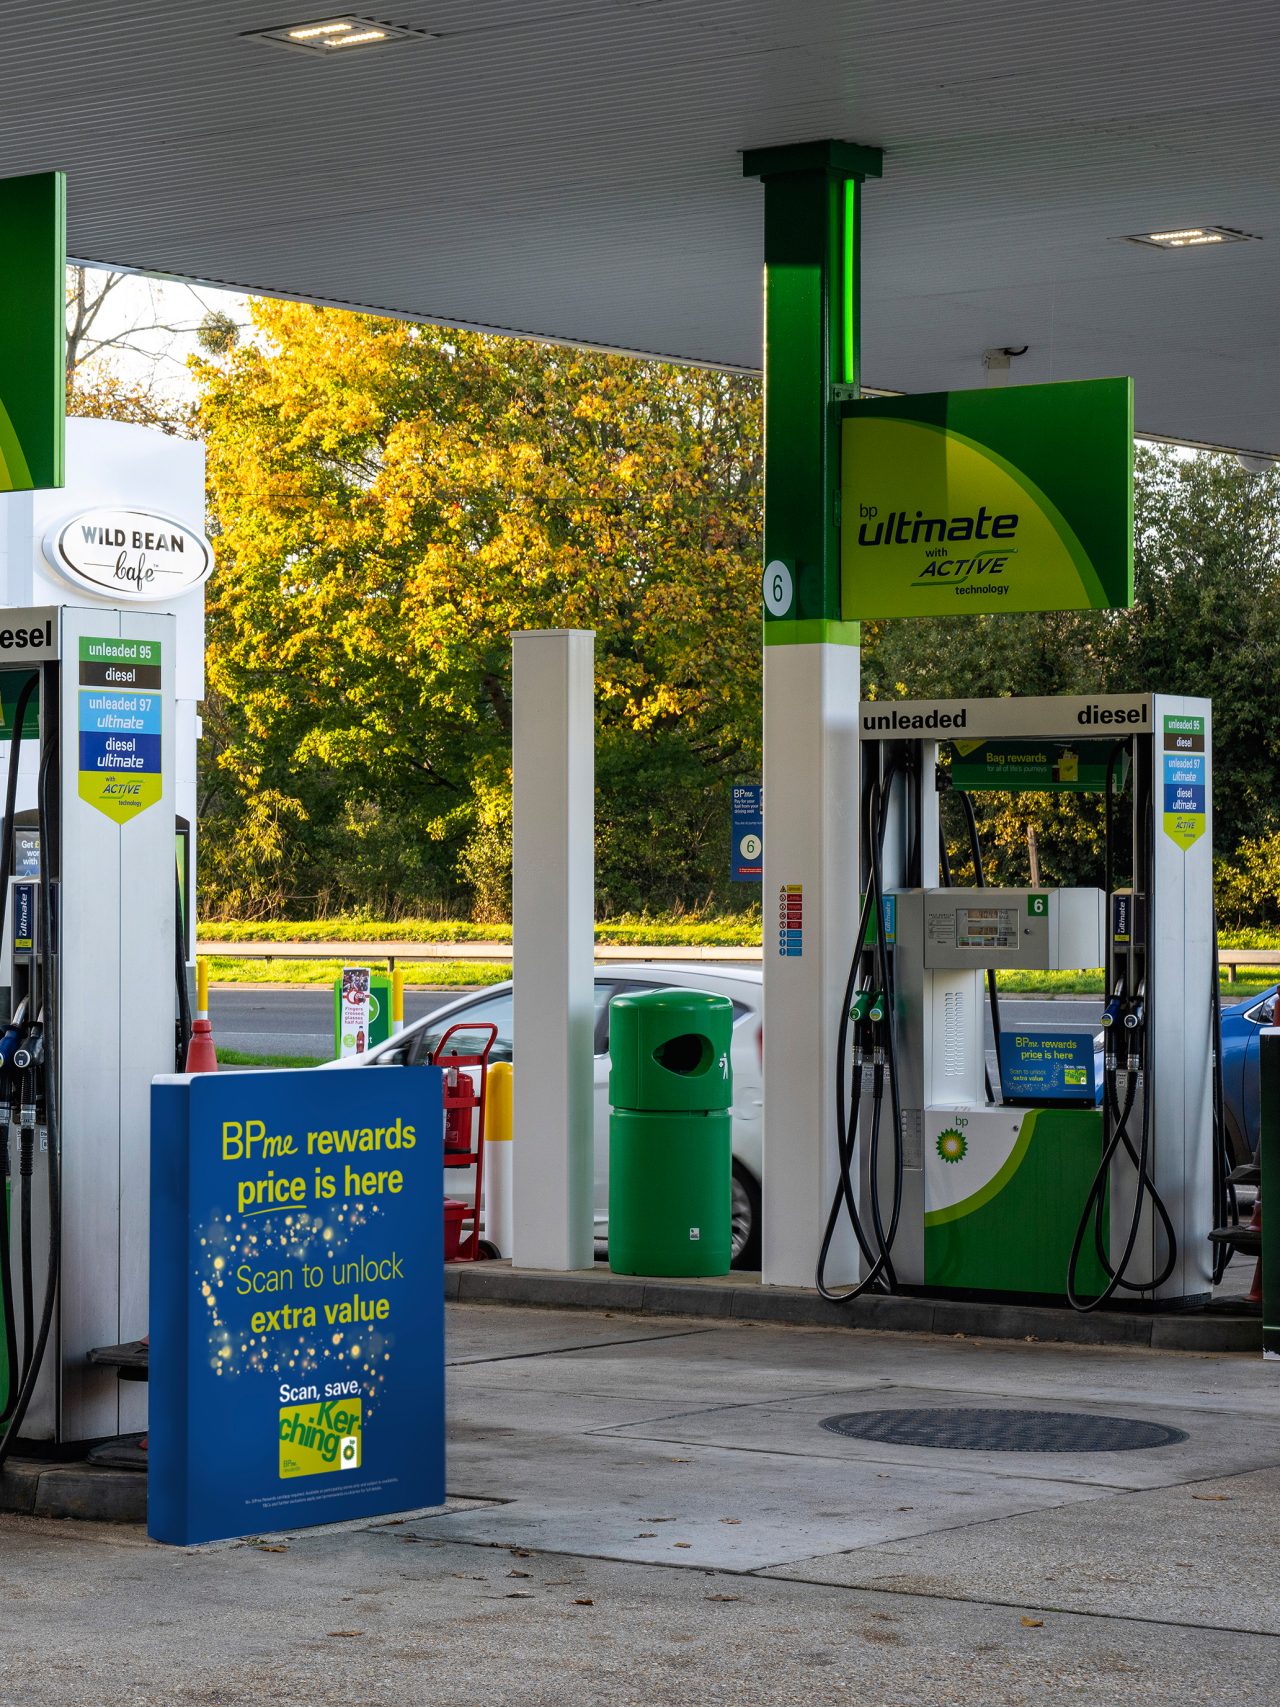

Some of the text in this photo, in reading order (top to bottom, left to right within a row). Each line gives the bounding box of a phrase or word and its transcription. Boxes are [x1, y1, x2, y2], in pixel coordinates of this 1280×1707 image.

[859, 503, 878, 521] bp
[858, 506, 1019, 546] ultimate
[81, 525, 185, 553] WILD BEAN
[925, 546, 948, 558] with
[918, 557, 1009, 578] ACTIVE
[773, 574, 783, 602] 6
[955, 584, 1010, 595] technology
[89, 643, 152, 659] unleaded 95
[105, 668, 136, 682] diesel
[89, 696, 152, 712] unleaded 97
[97, 714, 144, 729] ultimate
[863, 709, 967, 731] unleaded
[1077, 704, 1147, 725] diesel
[1168, 719, 1193, 730] unleaded
[105, 738, 136, 752] diesel
[1176, 737, 1192, 748] diesel
[97, 754, 144, 768] ultimate
[986, 752, 1047, 764] Bag rewards
[1168, 758, 1193, 769] unleaded
[1172, 771, 1197, 782] ultimate
[103, 783, 142, 795] ACTIVE
[1176, 788, 1193, 798] diesel
[1172, 800, 1197, 810] ultimate
[21, 840, 34, 849] Get
[747, 840, 754, 853] 6
[1034, 899, 1043, 913] 6
[20, 893, 28, 937] ultimate
[1041, 1039, 1077, 1048] rewards
[1021, 1050, 1073, 1061] price is here
[955, 1116, 969, 1128] bp
[307, 1117, 416, 1155] rewards
[238, 1165, 403, 1213] price is here
[236, 1251, 404, 1295] Scan to unlock
[251, 1294, 390, 1334] extra value
[279, 1380, 362, 1402] Scan, save,
[279, 1412, 340, 1462] ching
